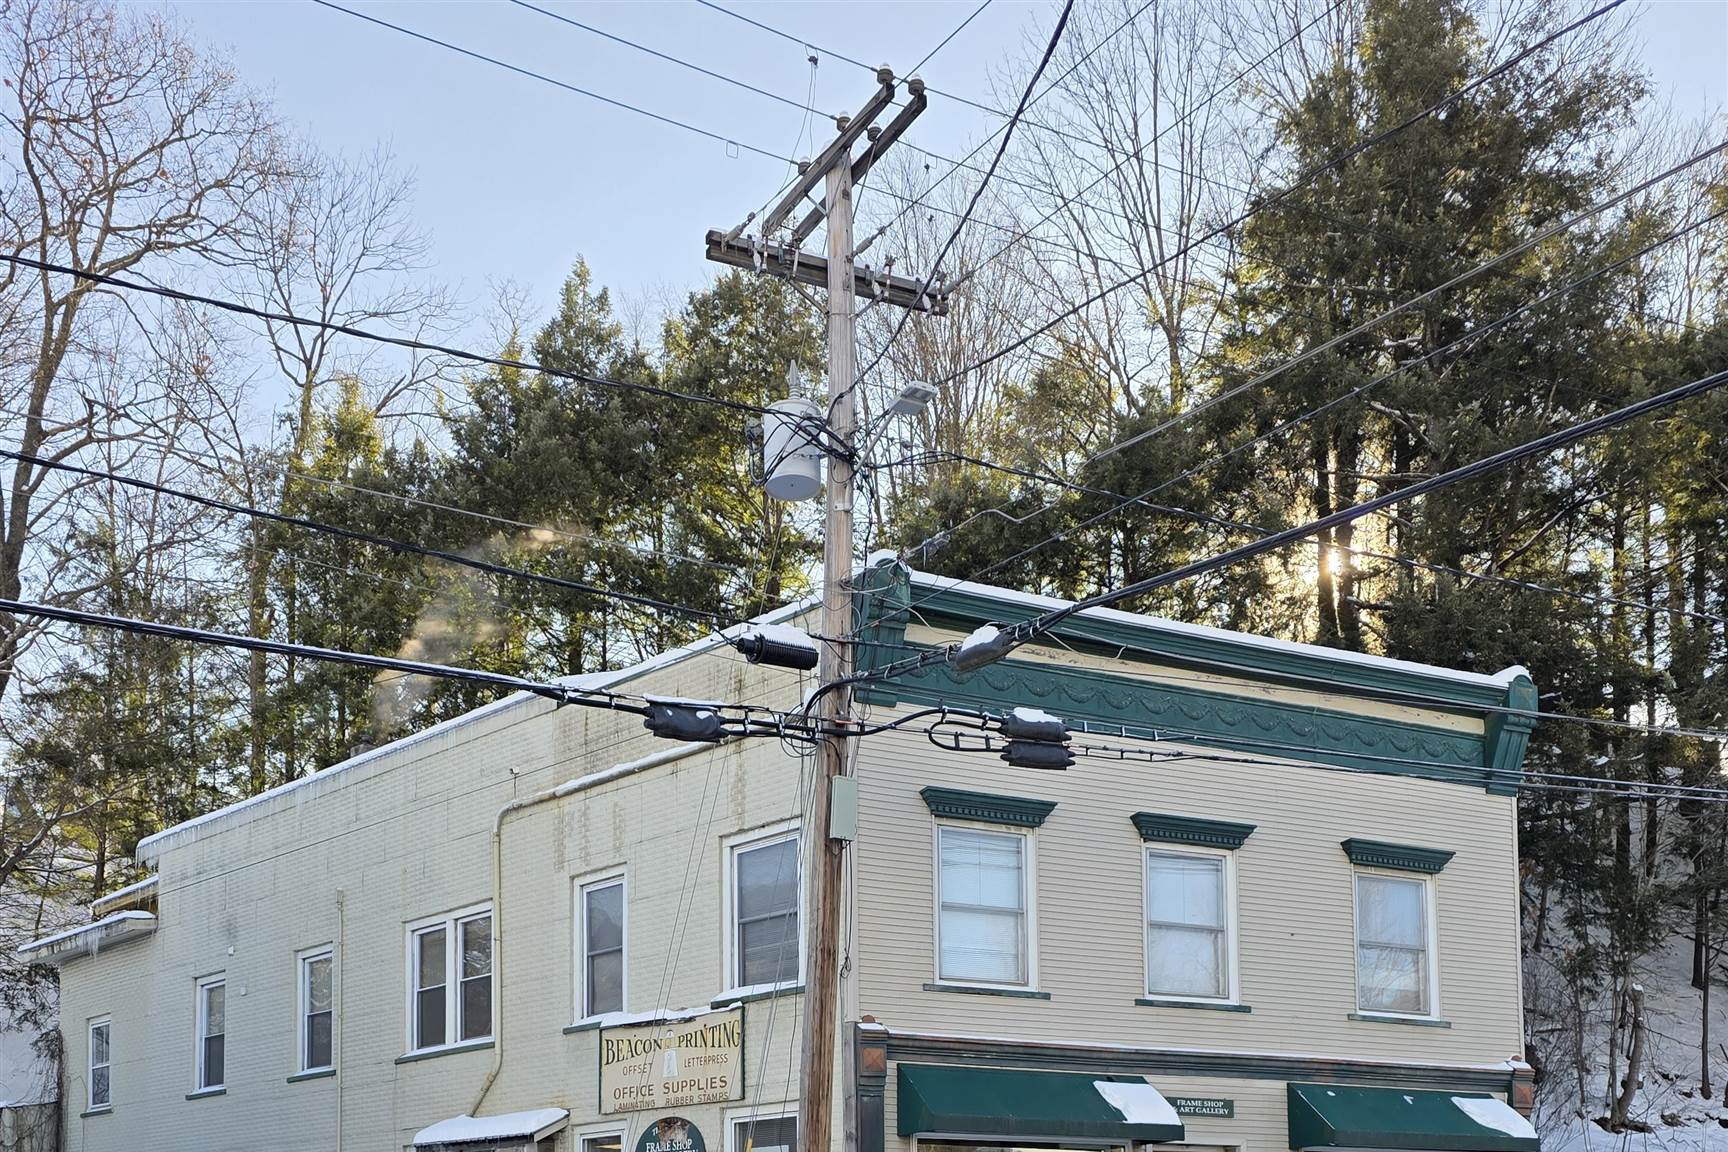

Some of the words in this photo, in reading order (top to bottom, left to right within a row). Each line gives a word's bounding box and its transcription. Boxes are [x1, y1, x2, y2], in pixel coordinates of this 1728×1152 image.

[604, 1038, 662, 1065] BEACON
[678, 1019, 741, 1048] PRINTING
[622, 1063, 653, 1076] OFFSET
[684, 1053, 728, 1068] LETTERPRESS
[613, 1084, 655, 1100] OFFICE
[663, 1075, 728, 1095] SUPPLIES
[665, 1095, 694, 1106] RUBBER
[697, 1092, 729, 1103] STAMPS
[1177, 1099, 1203, 1107] FRAME
[1203, 1100, 1224, 1108] SHOP
[1195, 1107, 1229, 1115] GALLERY
